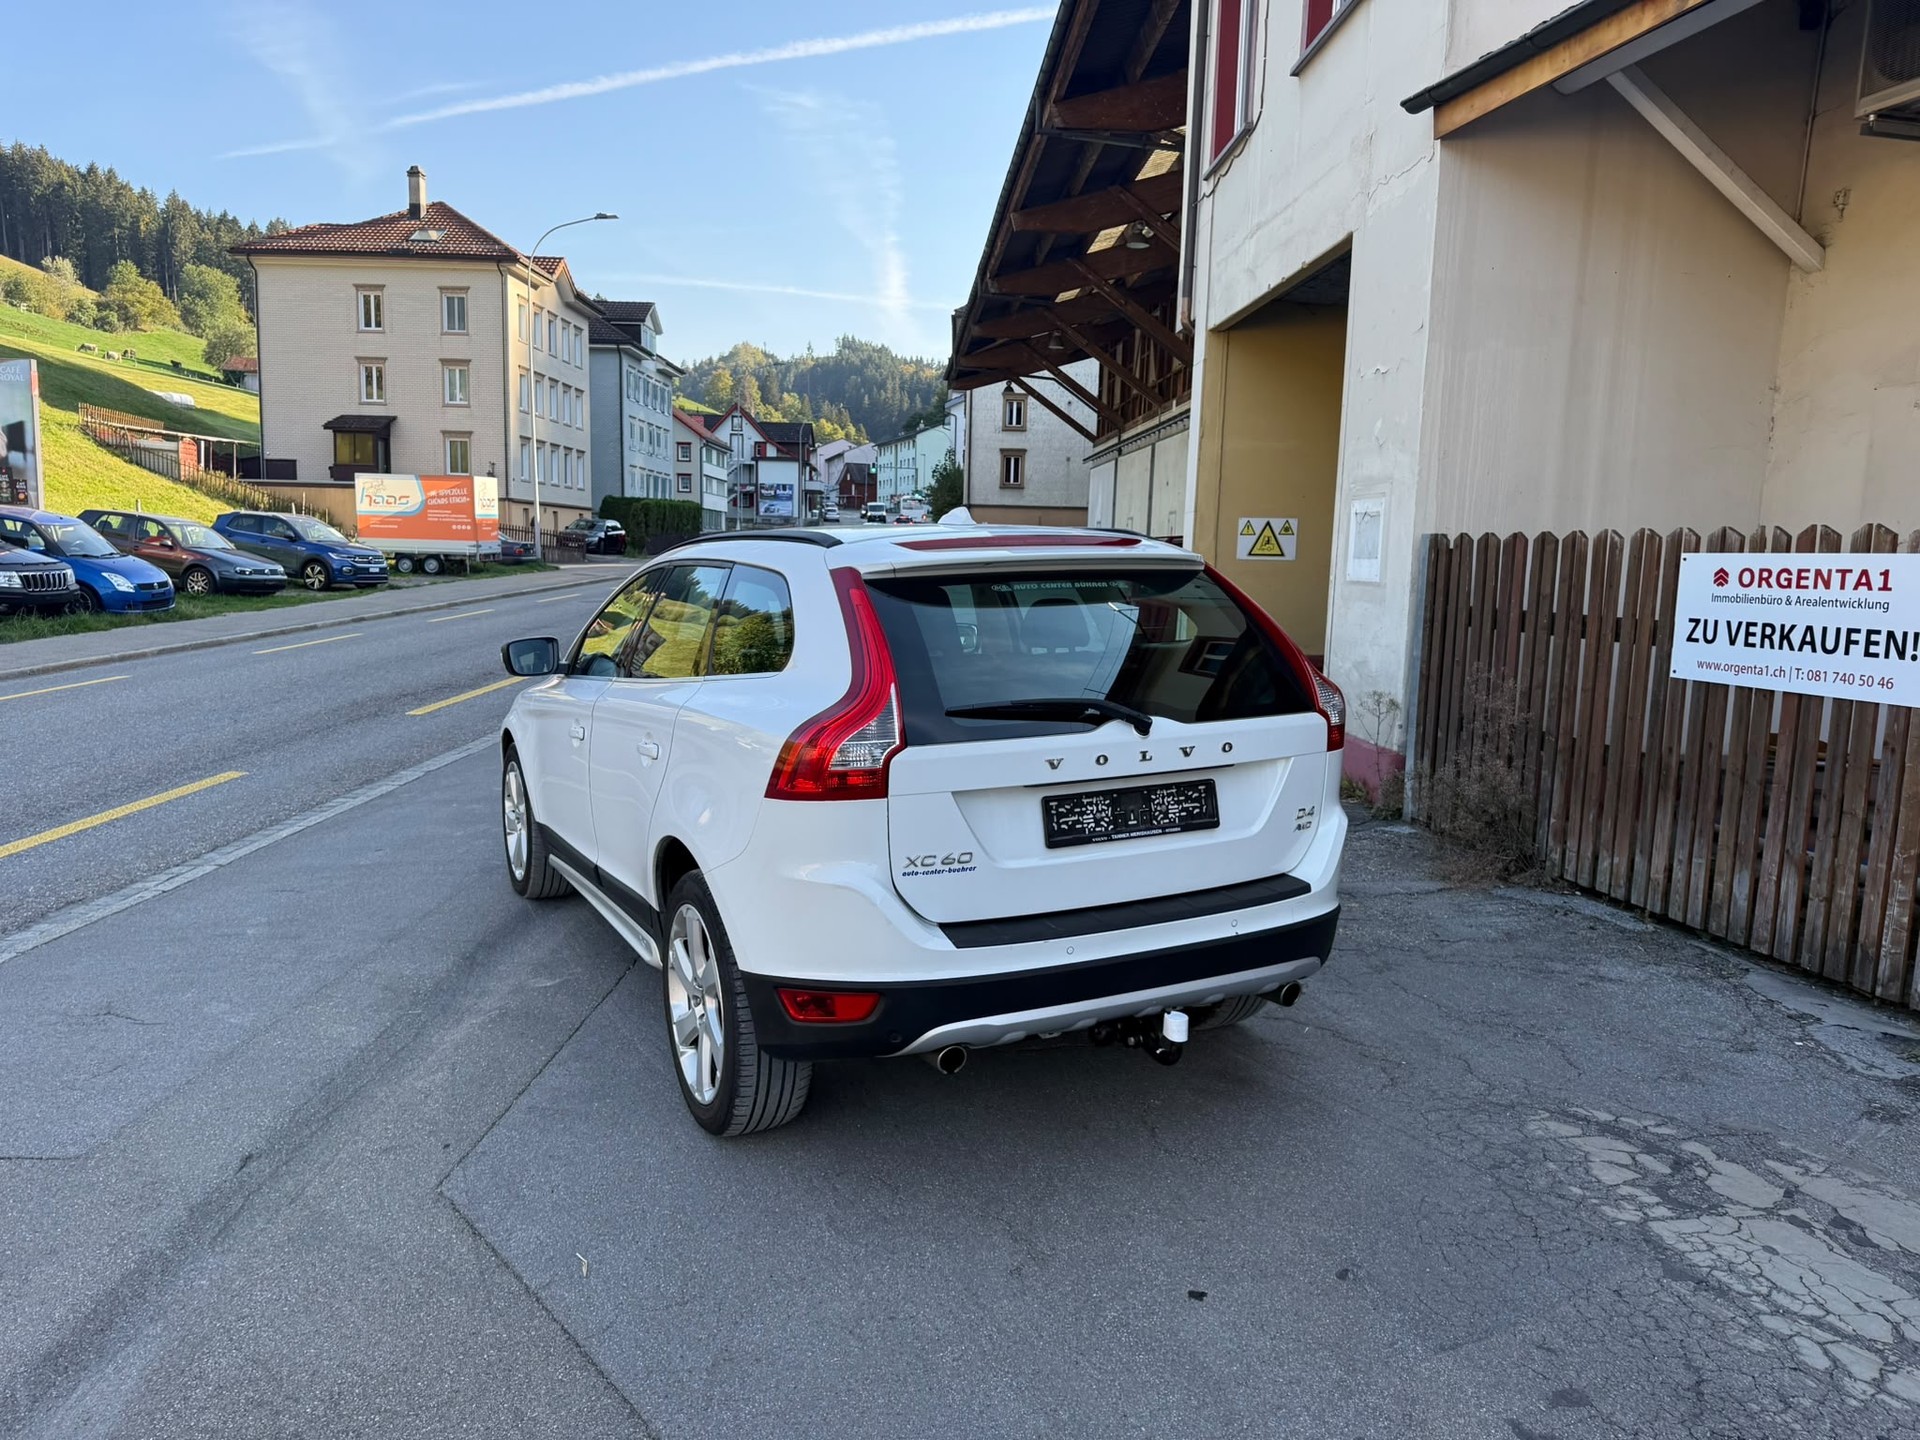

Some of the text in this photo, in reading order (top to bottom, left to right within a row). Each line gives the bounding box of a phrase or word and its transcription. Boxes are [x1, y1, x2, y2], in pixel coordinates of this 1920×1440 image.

[360, 487, 410, 506] haas
[1738, 567, 1893, 592] ORGENTA1
[1711, 593, 1890, 613] Immobilienbüro & Arealentwicklung
[1686, 617, 1920, 662] ZU VERKAUFEN!
[1696, 660, 1786, 678] www.orgenta1.ch
[1832, 671, 1855, 685] 740
[1858, 674, 1874, 687] 50
[1877, 676, 1894, 690] 46
[1045, 742, 1234, 770] VOLVO
[902, 865, 977, 877] auto-center-buehrer
